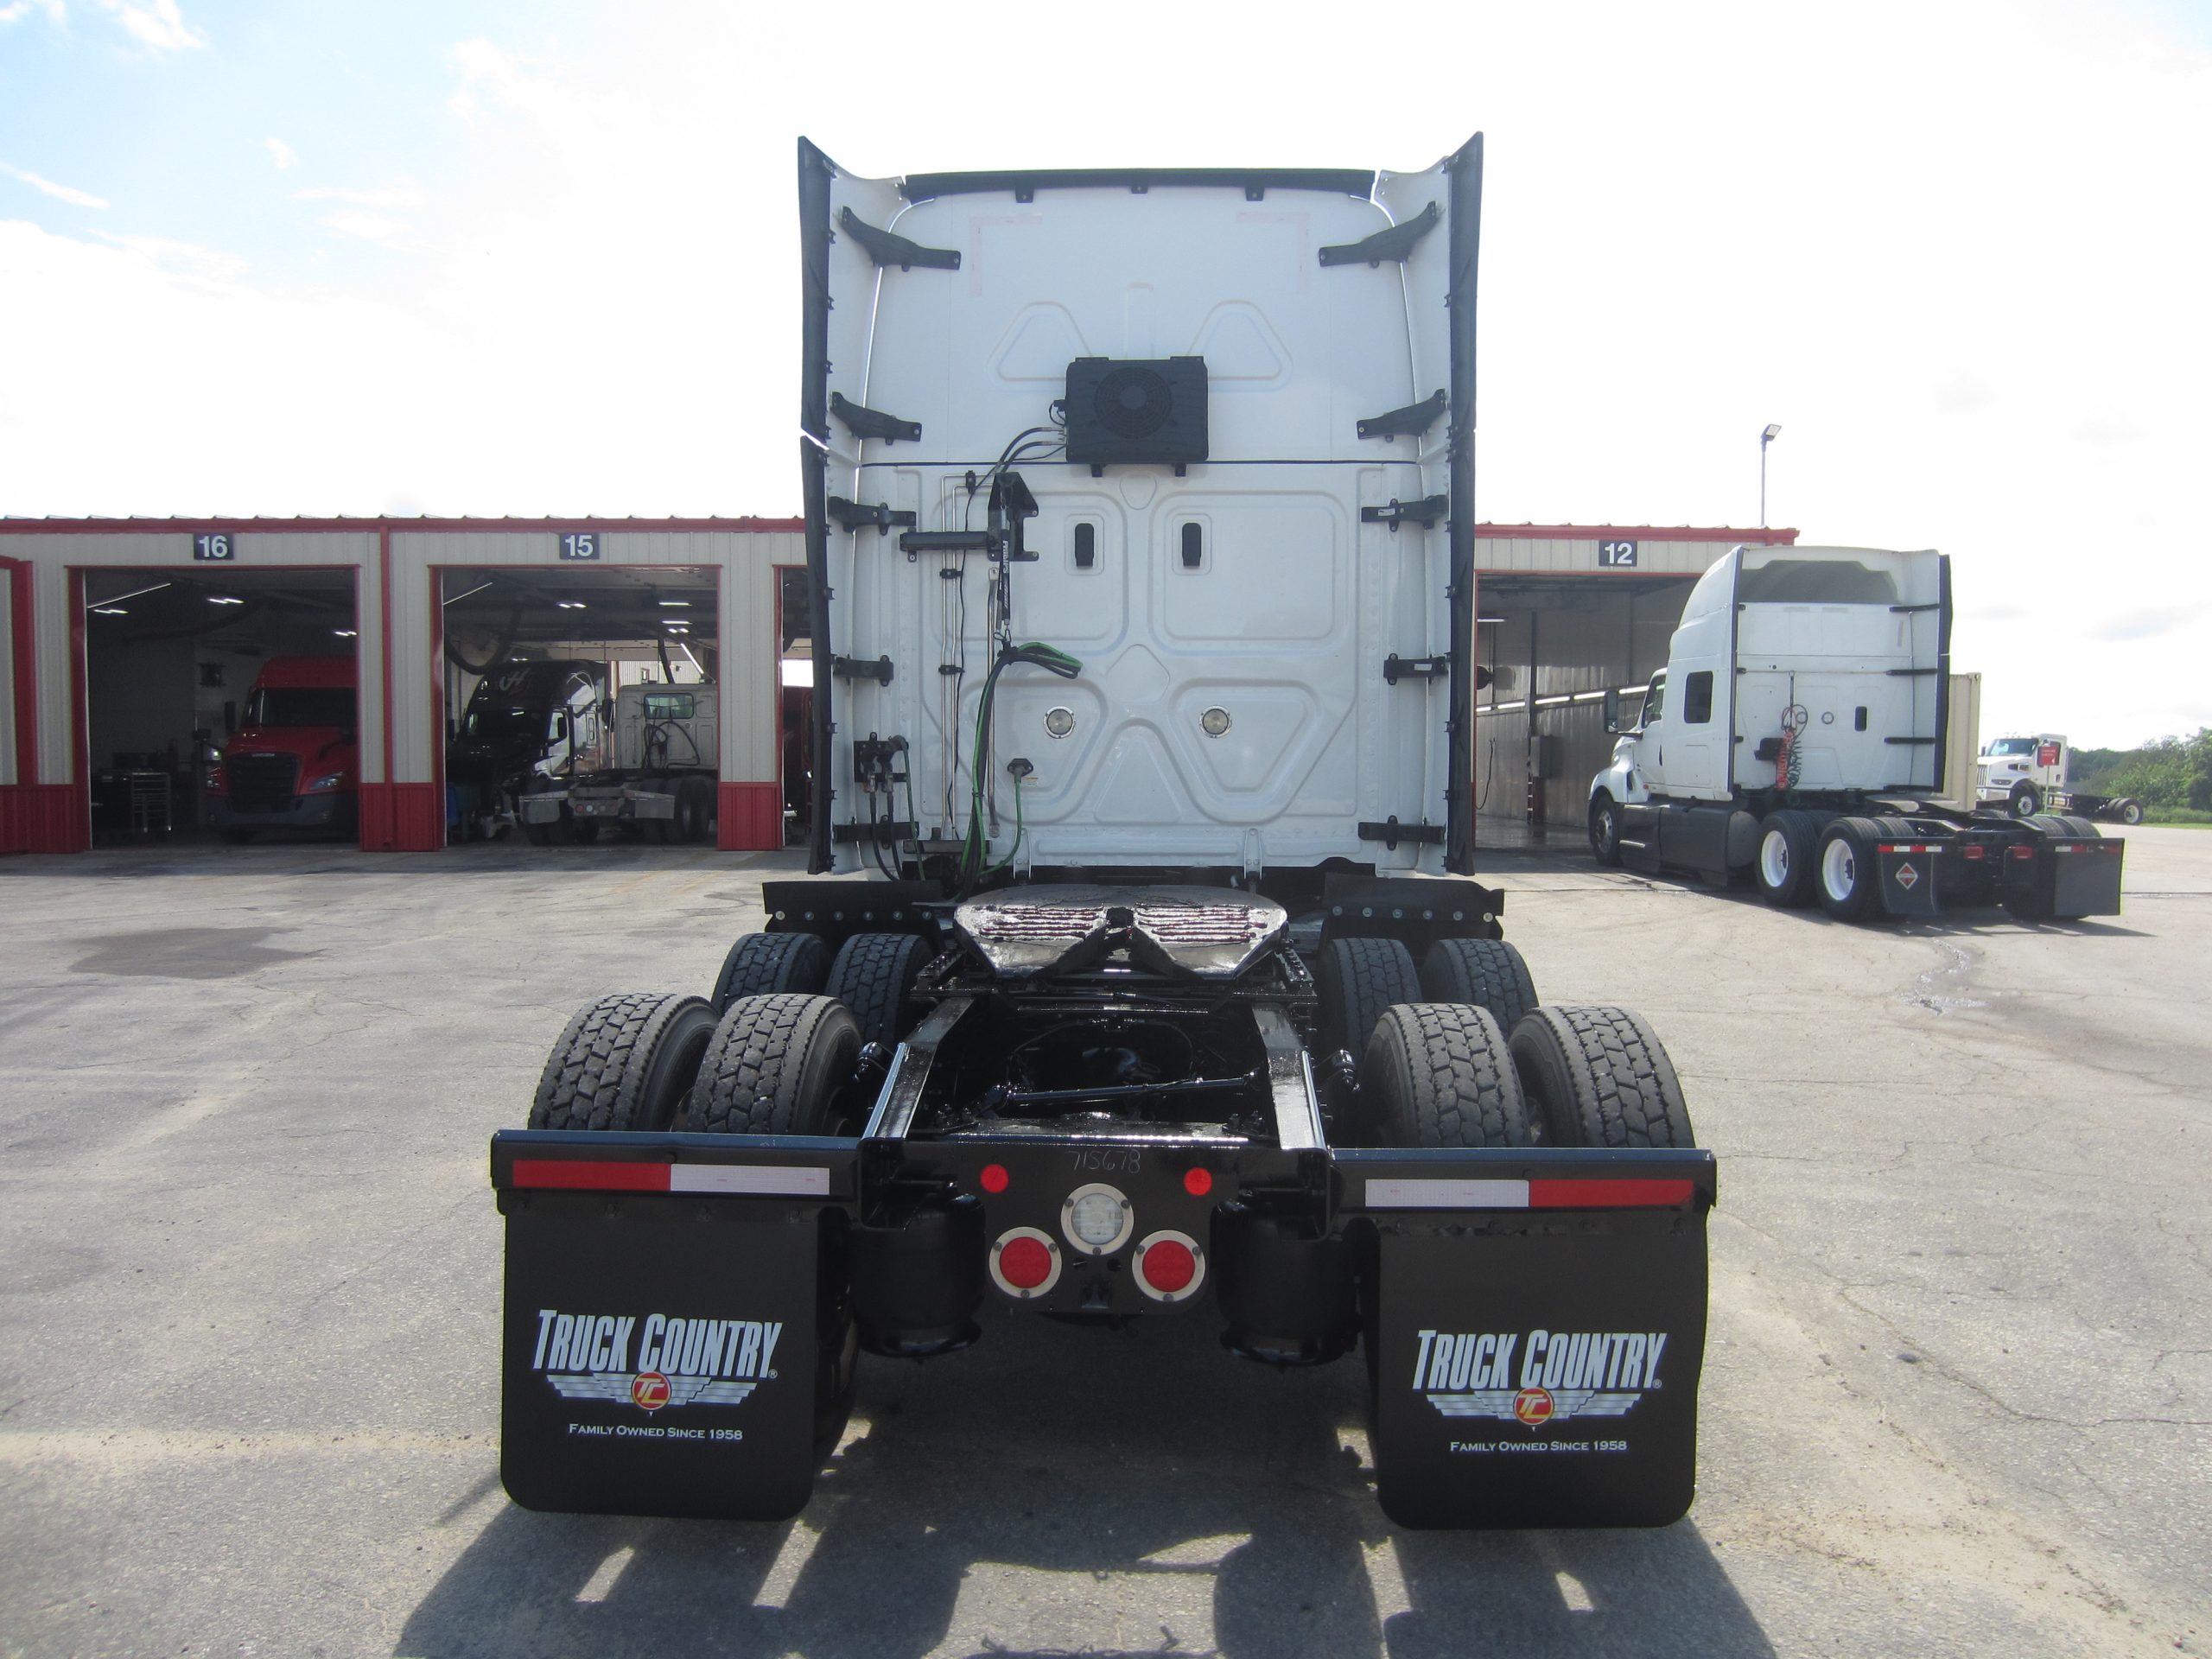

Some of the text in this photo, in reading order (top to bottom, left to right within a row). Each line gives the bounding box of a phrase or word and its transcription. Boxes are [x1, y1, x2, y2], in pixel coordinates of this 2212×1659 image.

[199, 535, 228, 558] 16
[564, 534, 594, 556] 15
[1605, 543, 1633, 564] 12
[1065, 1149, 1141, 1173] 715678
[533, 1309, 784, 1379] TRUCK COUNTRY
[1413, 1329, 1669, 1390] TRUCK COUNTRY
[569, 1423, 743, 1440] FAMILY OWNED SINCE 1958
[1450, 1440, 1628, 1452] FAMILY OWNED SINCE 1958
